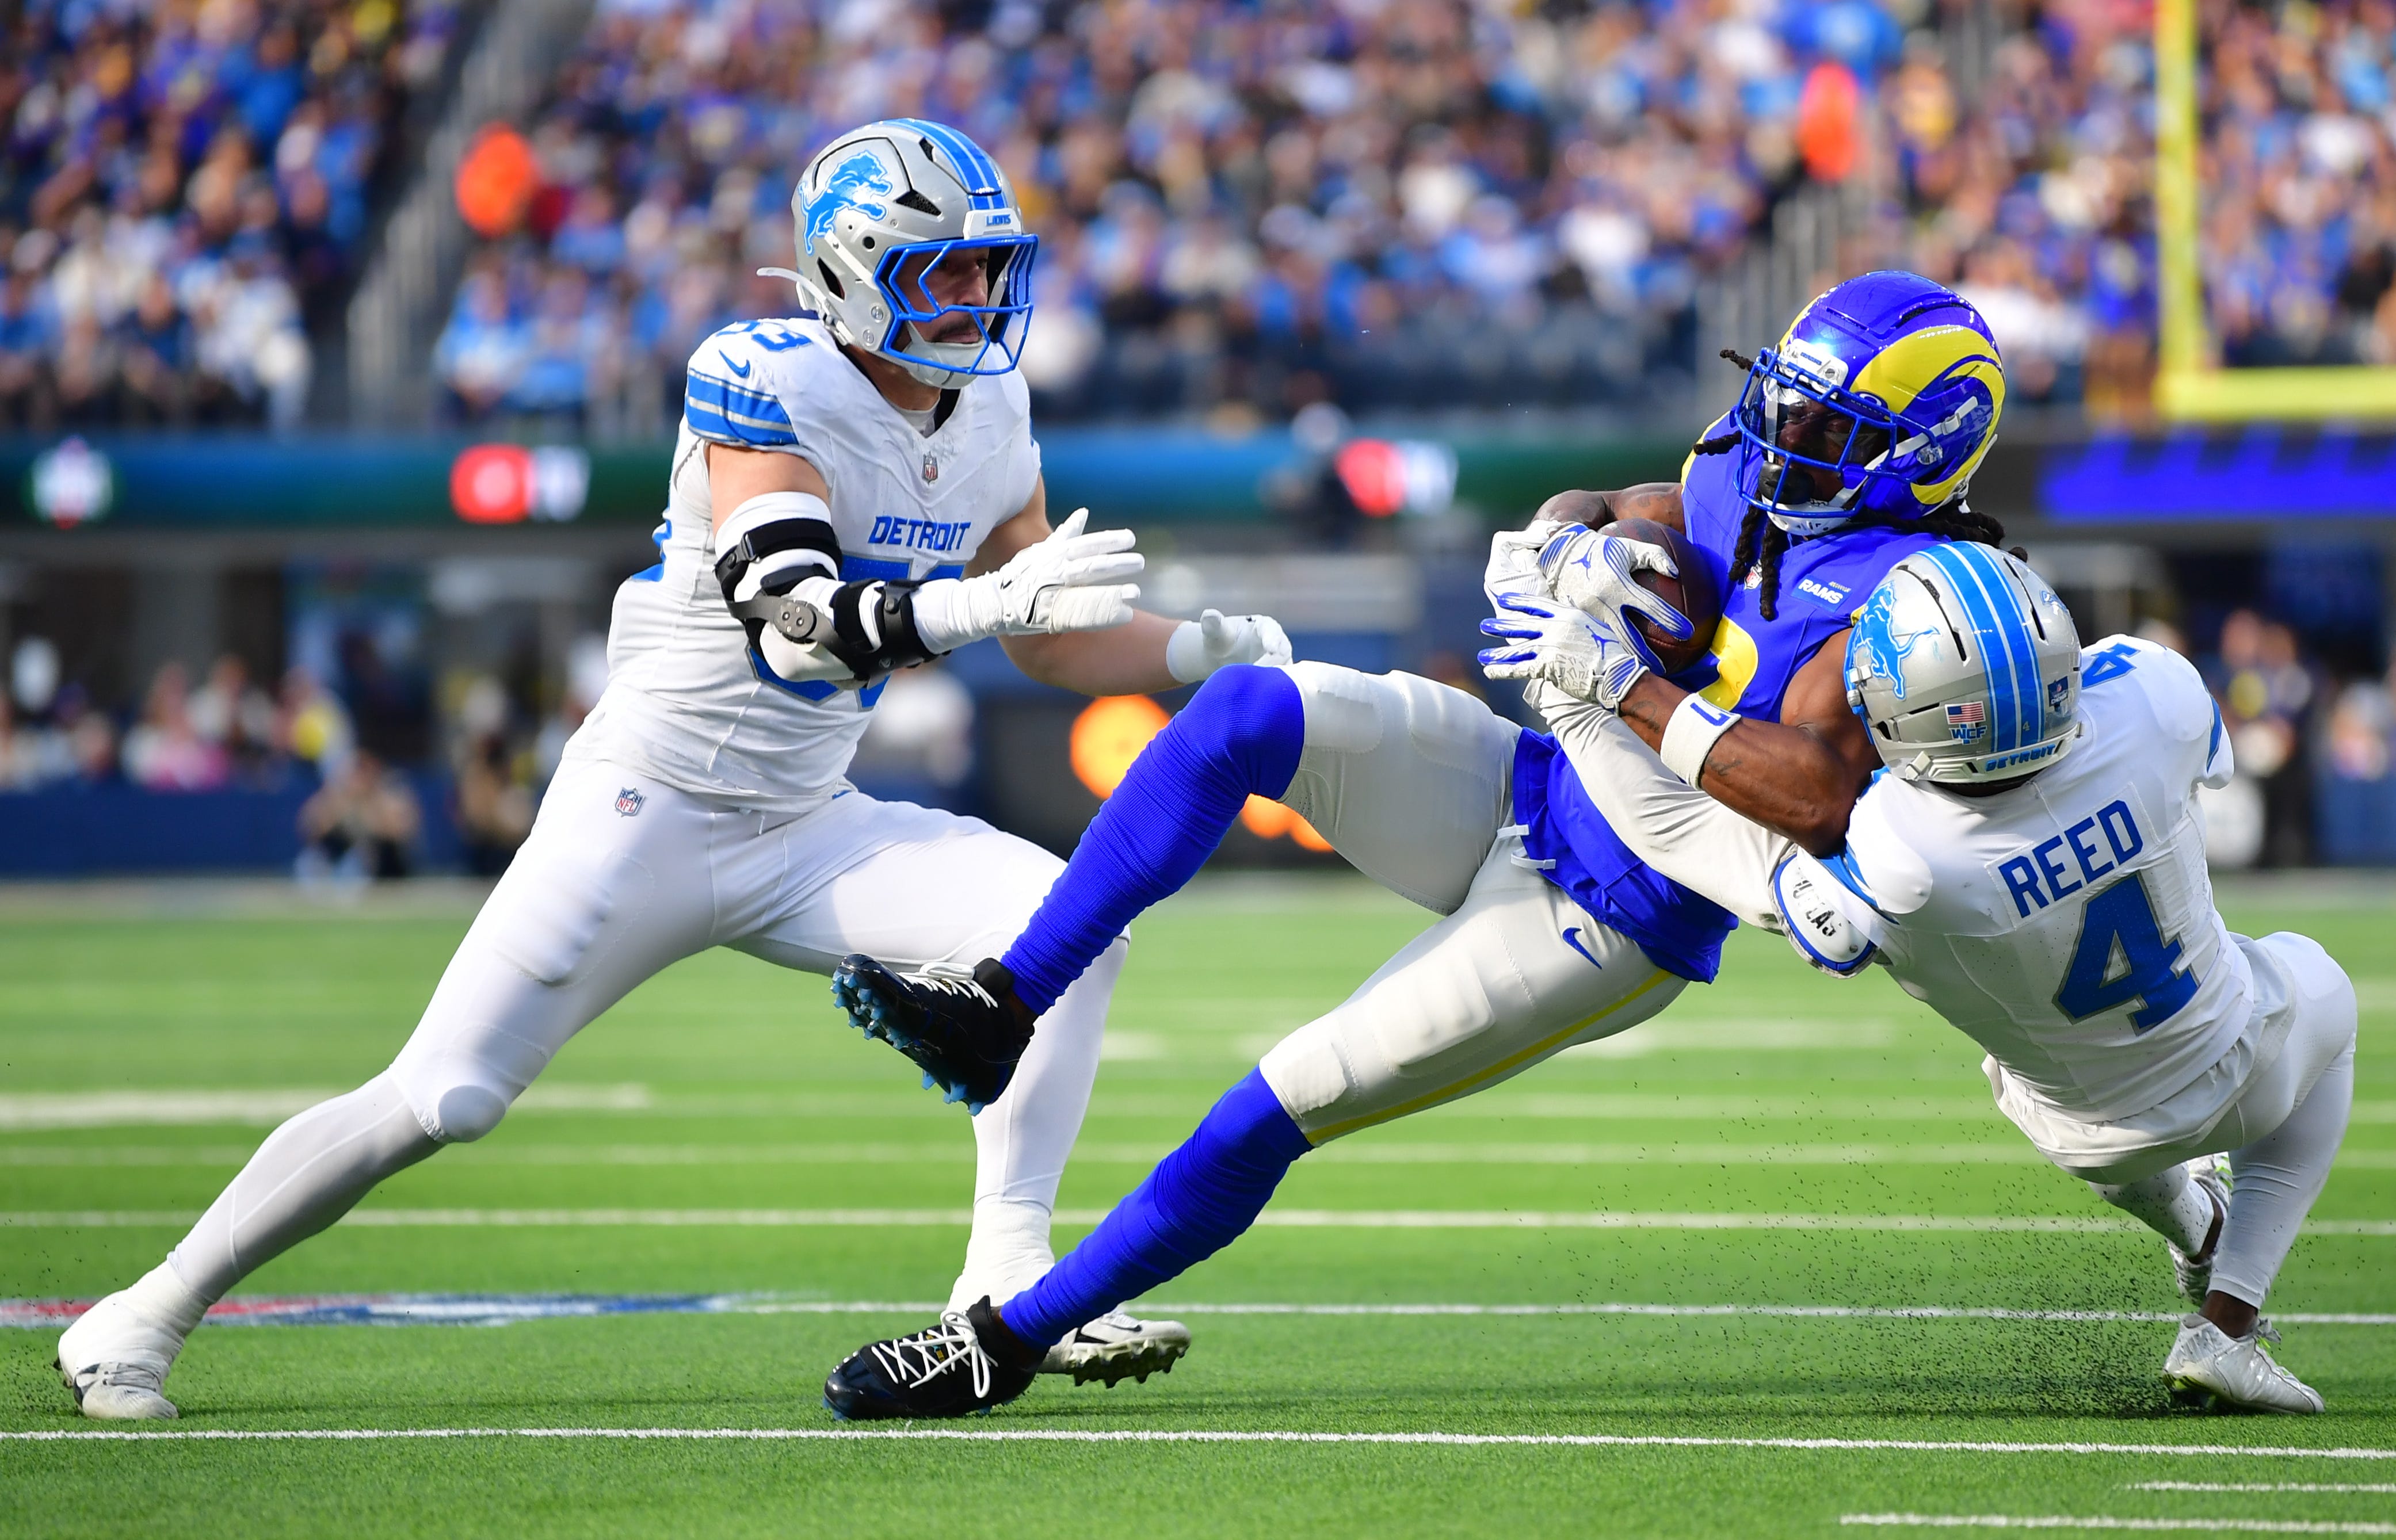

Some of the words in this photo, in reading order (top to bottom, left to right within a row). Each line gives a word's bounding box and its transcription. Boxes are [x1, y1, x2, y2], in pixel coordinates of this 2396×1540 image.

[986, 214, 1011, 226] LIONS
[868, 516, 971, 551] DETROIT
[1798, 579, 1843, 604] RAMS
[1950, 725, 1987, 740] WCF
[2023, 721, 2030, 731] 4
[1986, 744, 2056, 772] DETROIT
[617, 797, 634, 812] NFL
[1998, 800, 2143, 919] REED
[2051, 869, 2201, 1036] 4
